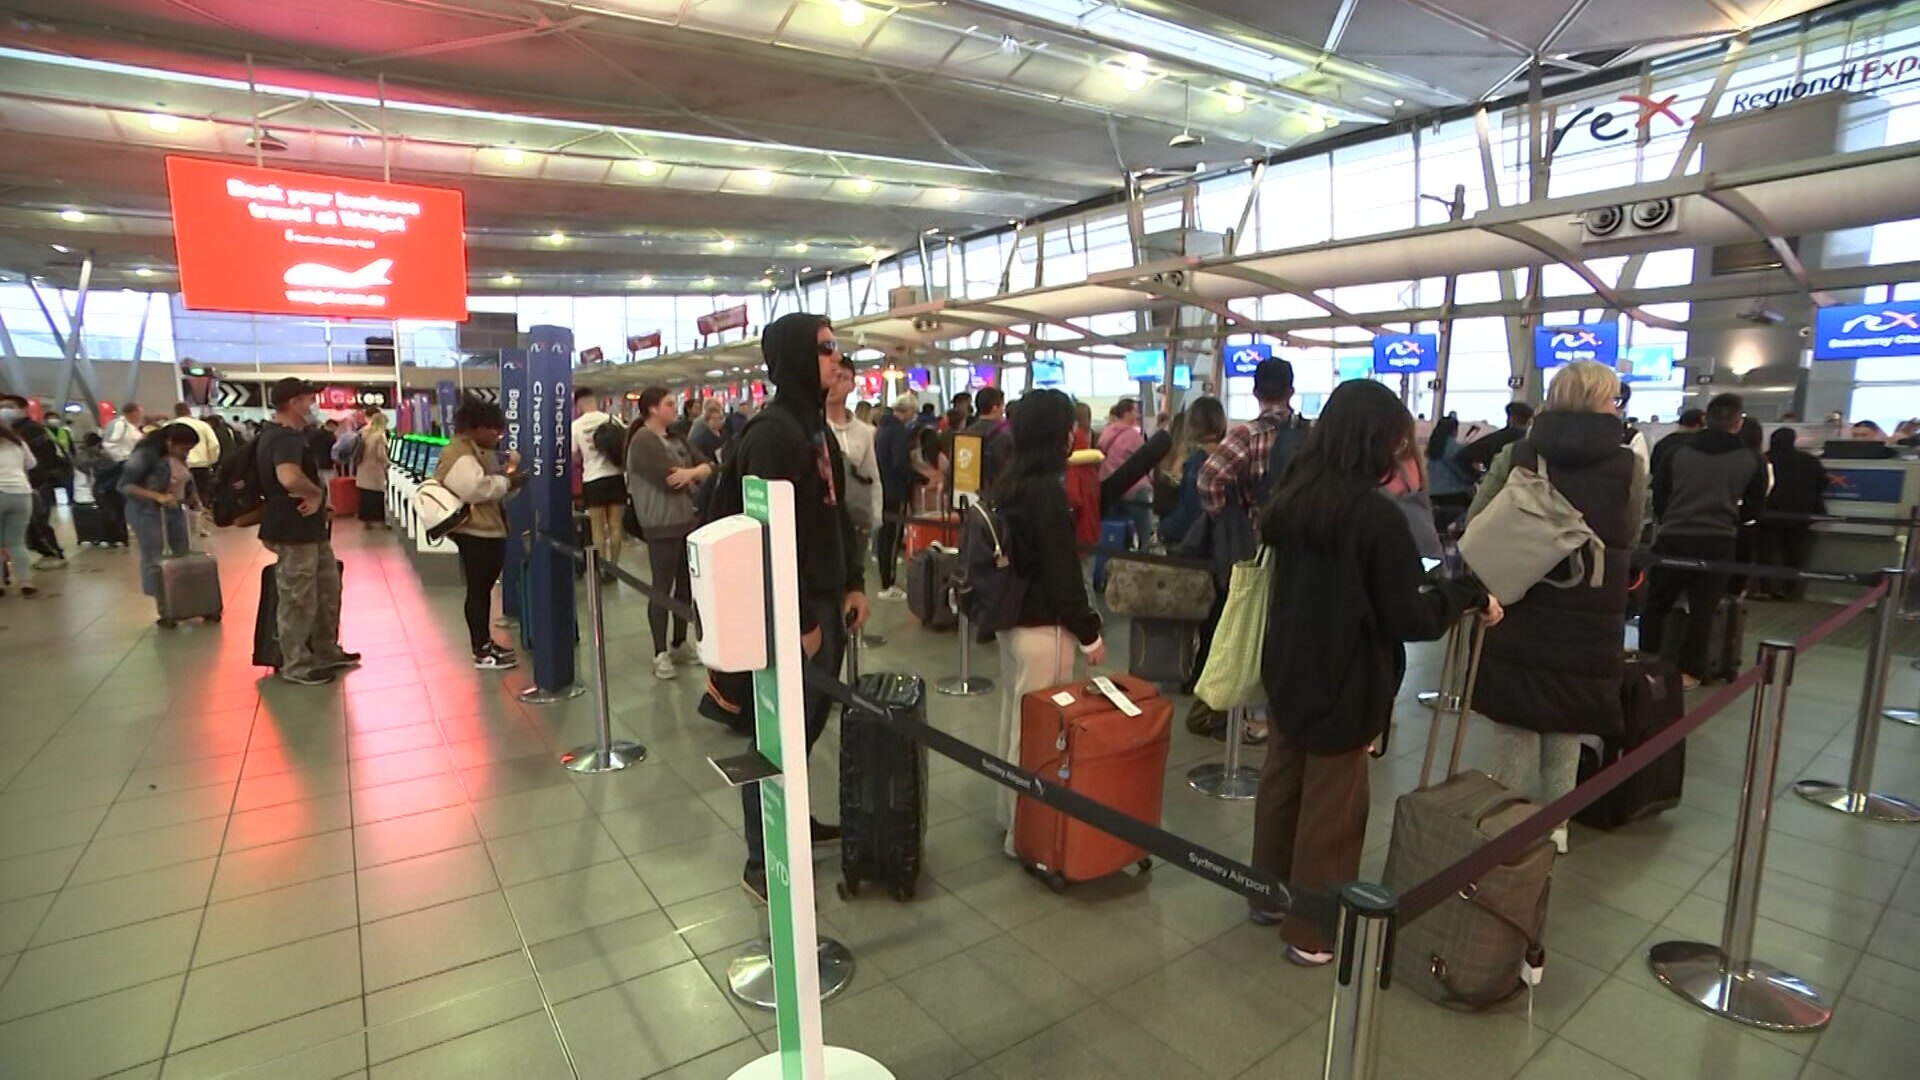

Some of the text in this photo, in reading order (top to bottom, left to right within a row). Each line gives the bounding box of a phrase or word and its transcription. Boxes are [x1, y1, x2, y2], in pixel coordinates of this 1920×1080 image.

[1732, 64, 1856, 112] Regional
[330, 390, 385, 406] Gates
[505, 388, 520, 450] Bag Dro
[1188, 852, 1270, 895] Sydney Airport
